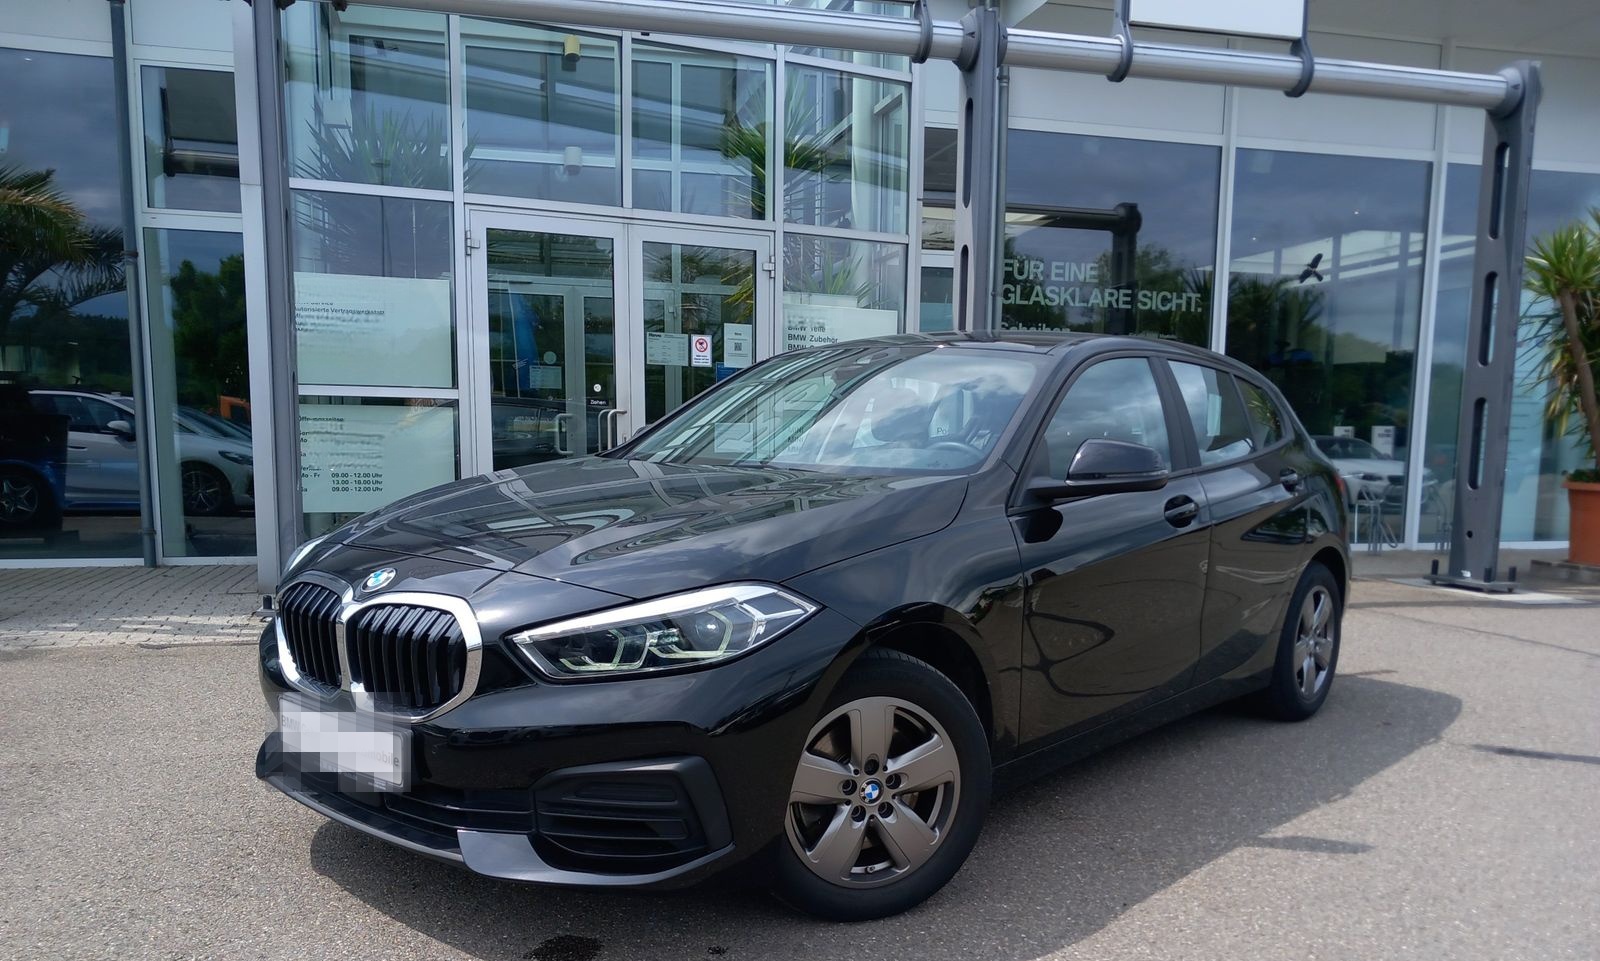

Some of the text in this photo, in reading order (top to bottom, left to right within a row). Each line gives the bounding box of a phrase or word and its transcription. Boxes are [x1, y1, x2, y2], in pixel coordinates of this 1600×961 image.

[1002, 256, 1099, 283] FÜR EINE
[1001, 284, 1203, 313] GLASKLARE SICHT.
[787, 333, 807, 342] BMW
